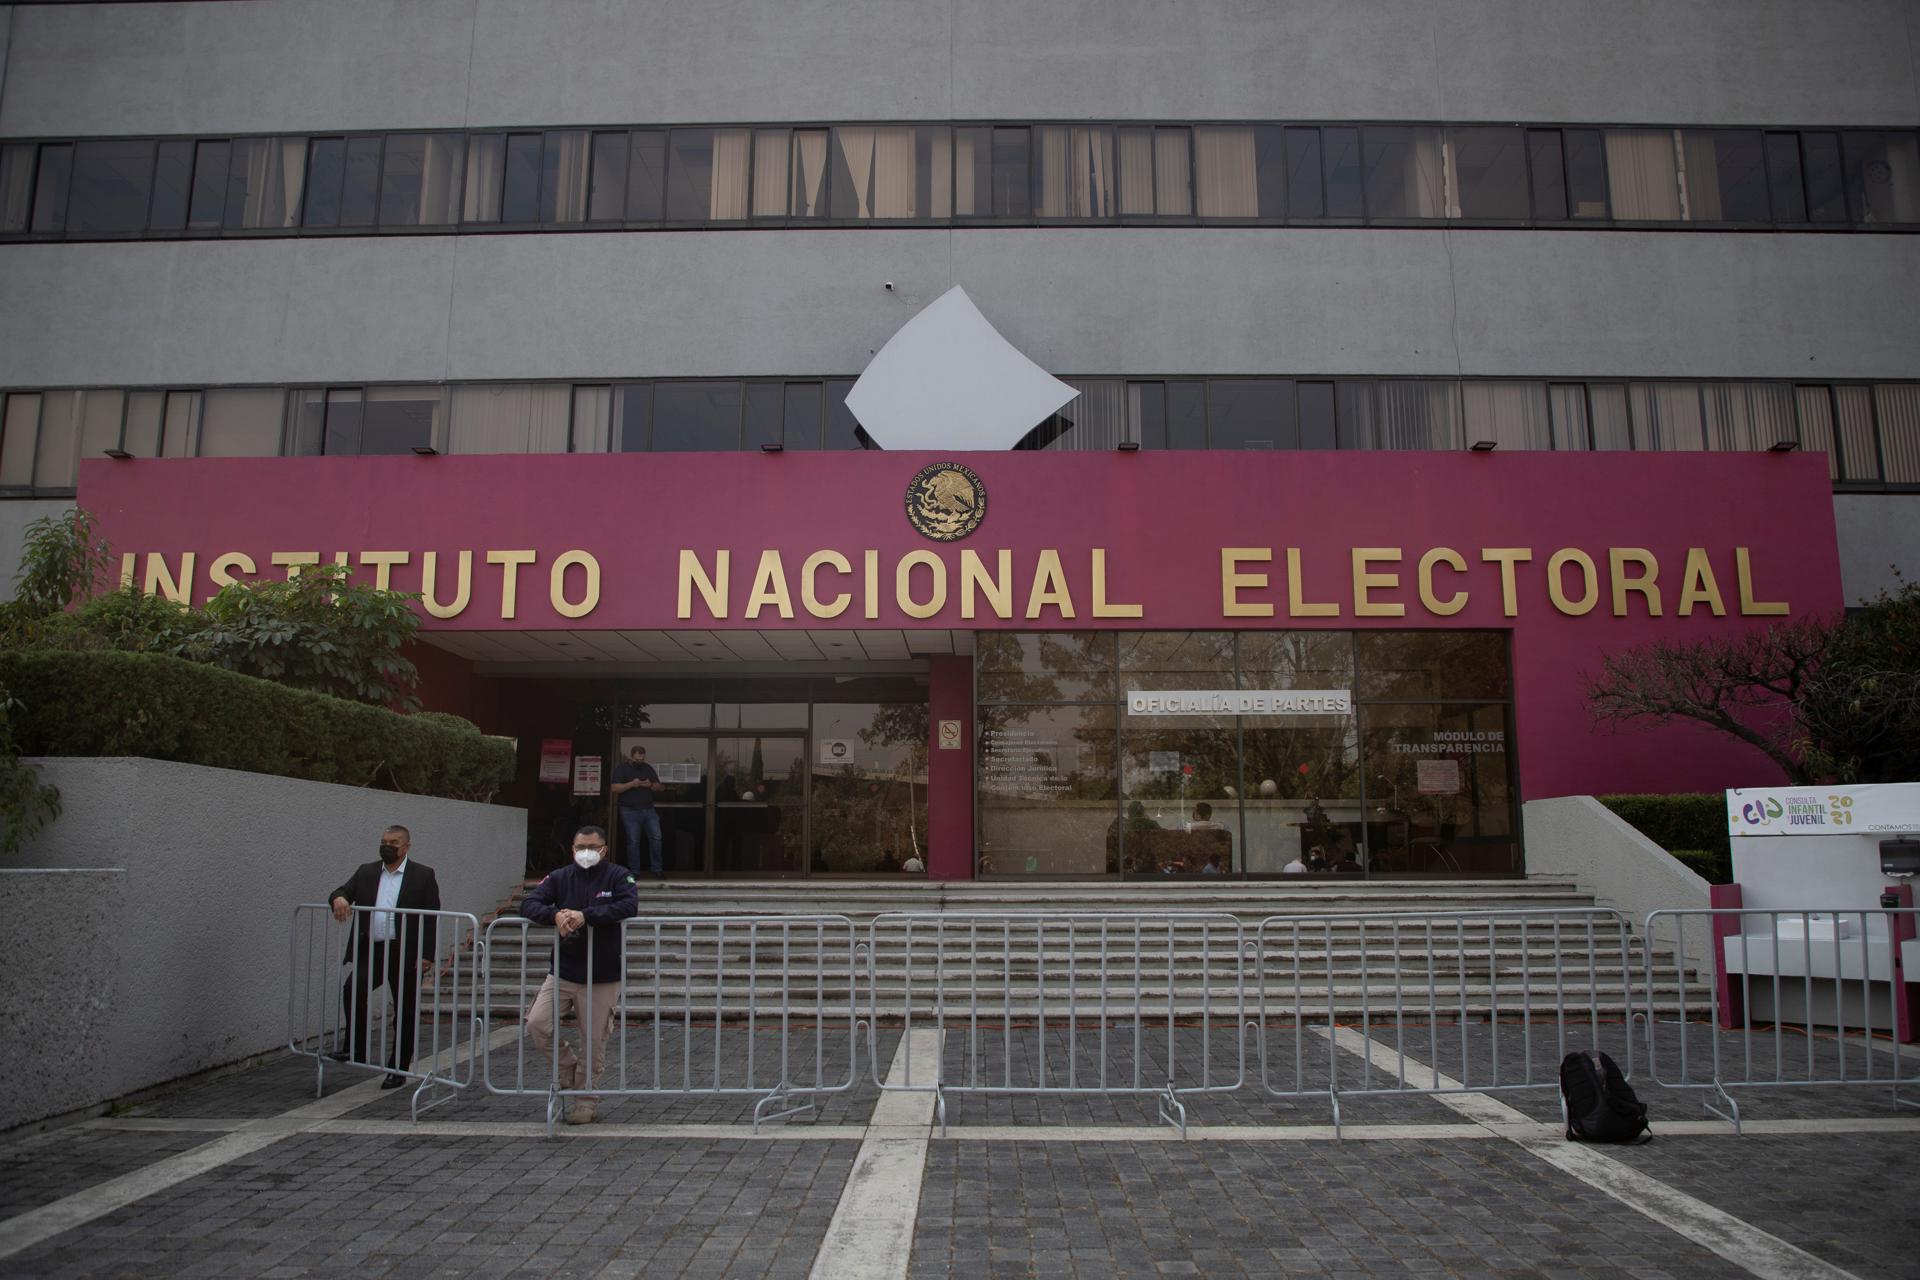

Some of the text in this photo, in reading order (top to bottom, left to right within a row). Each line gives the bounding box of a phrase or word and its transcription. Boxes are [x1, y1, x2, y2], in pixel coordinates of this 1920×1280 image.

[906, 462, 986, 504] ESTADOS UNIDOS MEXICANOS
[119, 547, 1790, 619] INSTITUTO NACIONAL ELECTORAL
[1132, 694, 1349, 713] OFICIALÍA DE PARTES
[1433, 729, 1505, 742] MÓDULO DE
[1393, 743, 1505, 753] TRANSPARENCIA
[1785, 796, 1817, 805] CONSULTA
[1788, 803, 1827, 814] INFANTIL
[1790, 814, 1827, 825] JUVENIL
[1867, 823, 1912, 831] CONTAMOS
